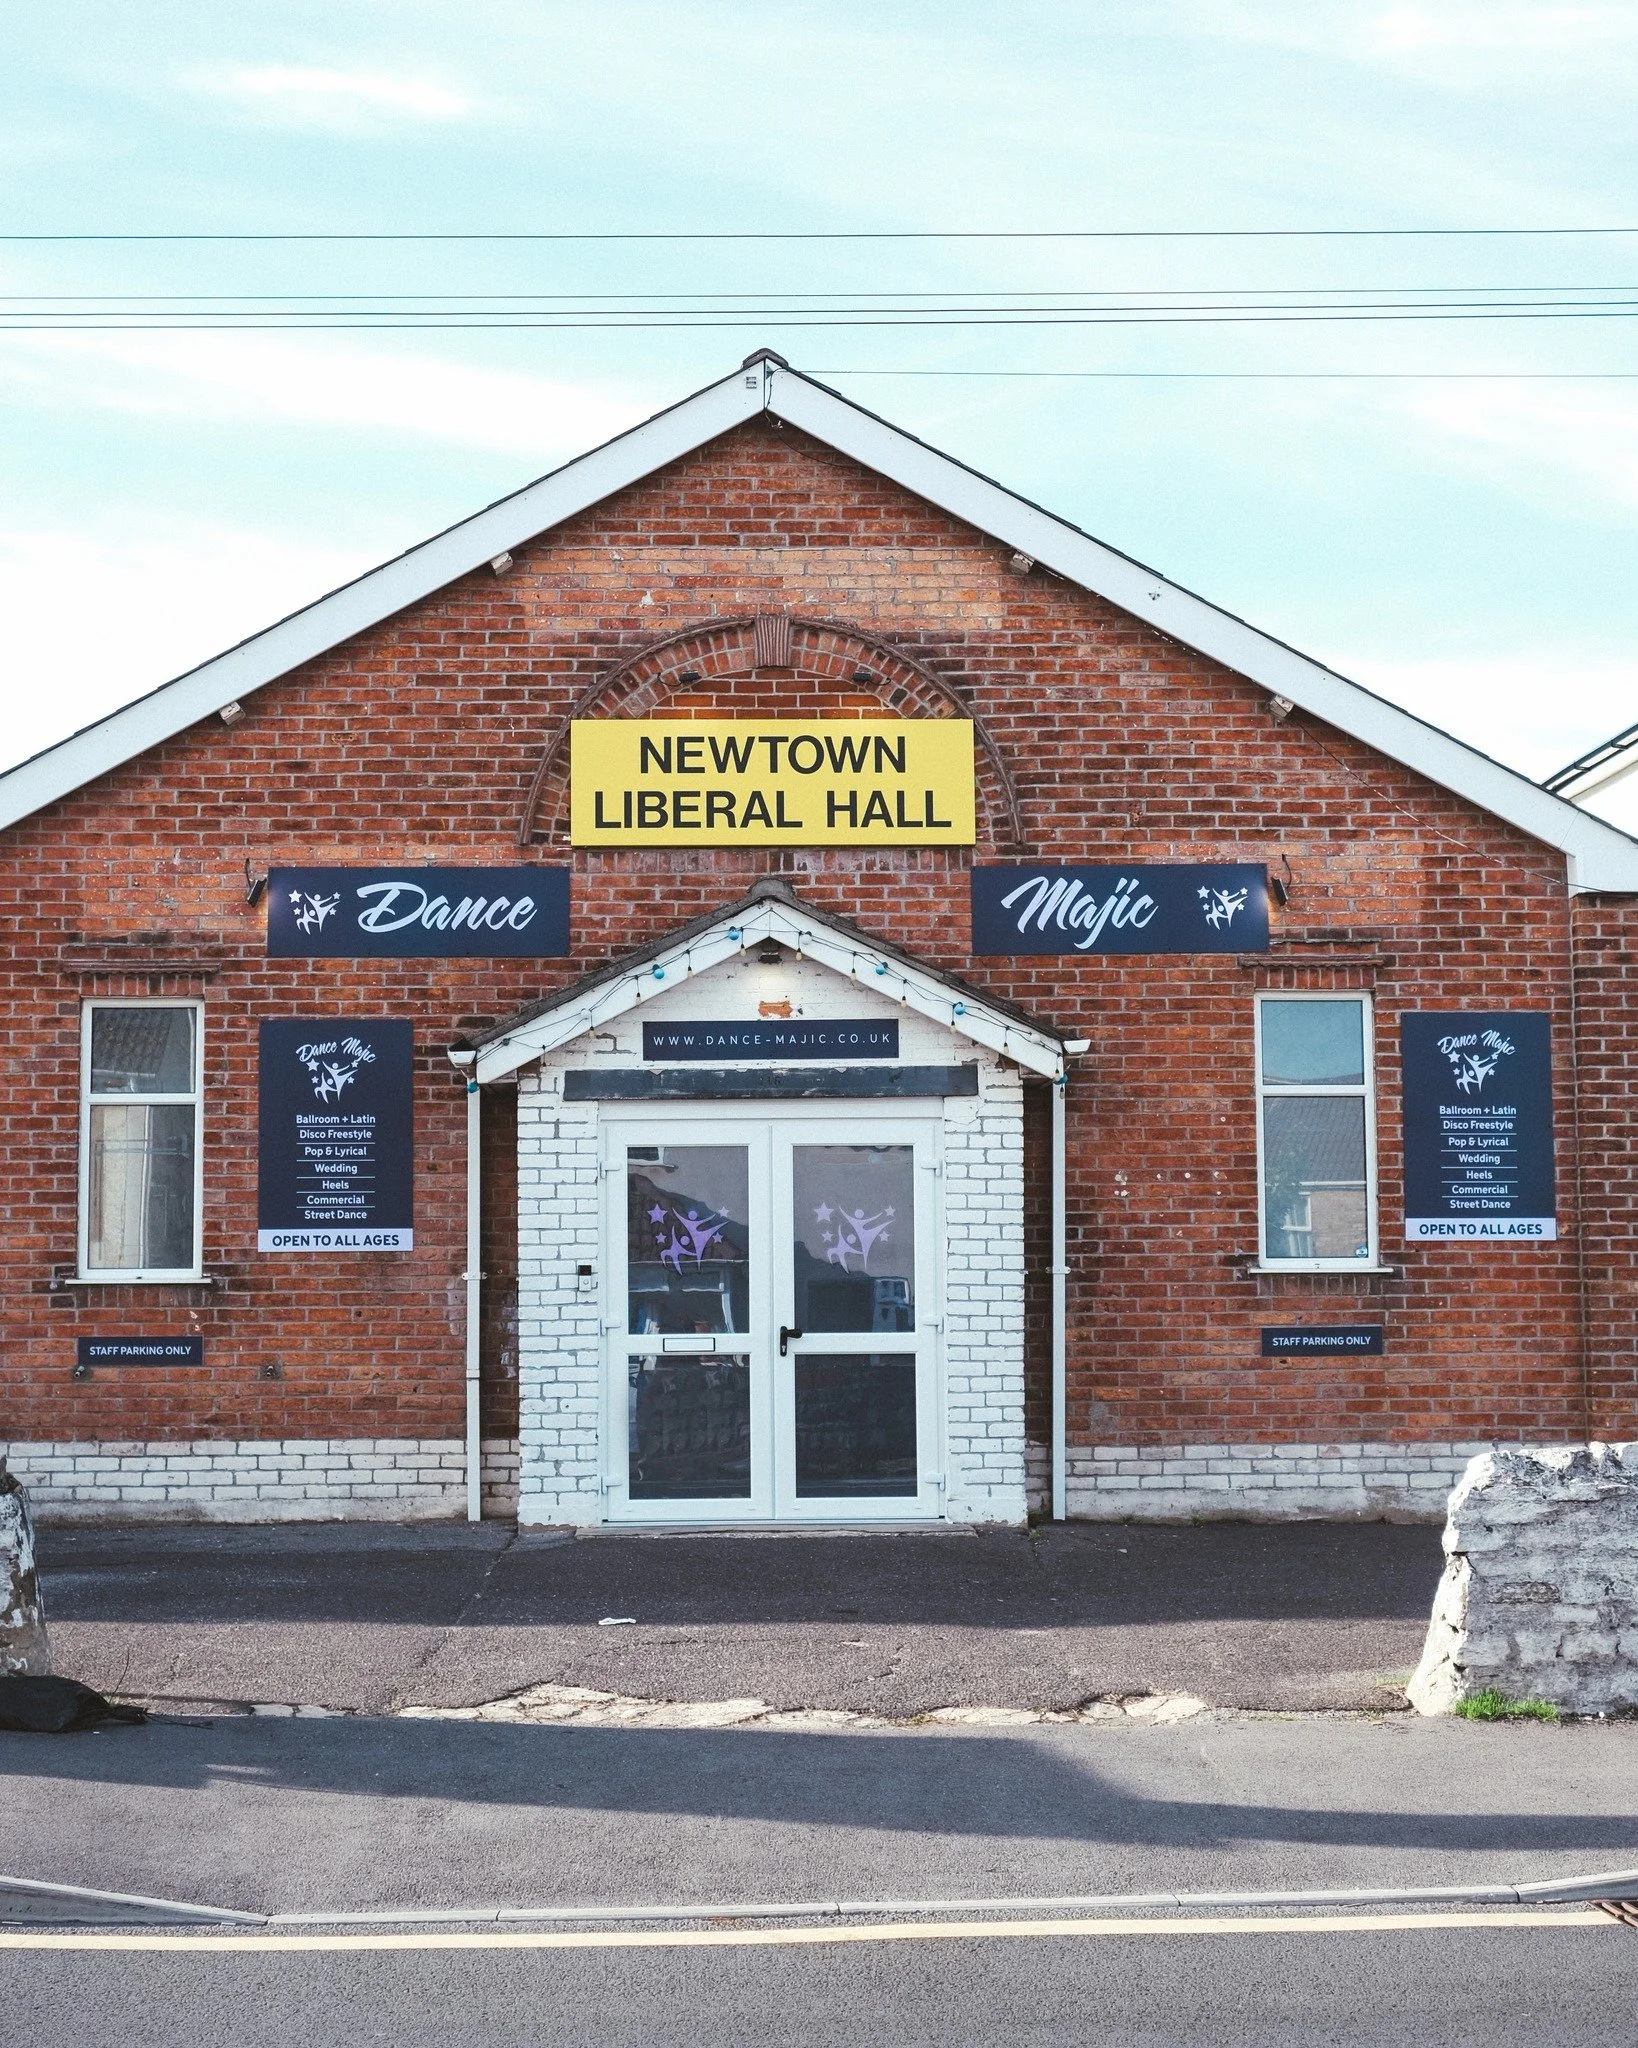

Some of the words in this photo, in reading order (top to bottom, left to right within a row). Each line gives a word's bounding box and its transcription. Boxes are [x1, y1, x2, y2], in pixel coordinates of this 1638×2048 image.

[640, 734, 906, 775] NEWTOWN
[594, 790, 803, 829] LIBERAL
[826, 790, 952, 828] HALL
[356, 881, 538, 933] Dance
[1000, 876, 1159, 949] Majic
[653, 1032, 890, 1046] WWW.DANCE-MAJIC.CO.UK
[1437, 1034, 1478, 1054] Dance
[1480, 1029, 1516, 1055] Majic
[295, 1042, 338, 1063] Dance
[340, 1037, 377, 1063] Majic
[1439, 1105, 1482, 1115] Ballroom
[1492, 1105, 1517, 1115] Latin
[296, 1114, 340, 1124] Ballroom
[350, 1114, 376, 1124] Latin
[1443, 1120, 1469, 1130] Disco
[1470, 1120, 1514, 1132] Freestyle
[300, 1129, 326, 1139] Disco
[327, 1129, 372, 1141] Freestyle
[1448, 1137, 1467, 1148] Pop
[1468, 1137, 1476, 1147] &
[1477, 1137, 1509, 1148] Lyrical
[304, 1146, 324, 1158] Pop
[325, 1146, 333, 1156] &
[334, 1146, 367, 1158] Lyrical
[1458, 1153, 1501, 1165] Wedding
[314, 1163, 358, 1175] Wedding
[1466, 1170, 1493, 1180] Heels
[322, 1180, 350, 1190] Heels
[1451, 1184, 1508, 1195] Commercial
[306, 1194, 365, 1205] Commercial
[1449, 1199, 1480, 1209] Street
[1481, 1199, 1511, 1209] Dance
[304, 1209, 335, 1220] Street
[337, 1209, 368, 1220] Dance
[1419, 1223, 1456, 1235] OPEN
[1458, 1223, 1477, 1235] TO
[1479, 1223, 1505, 1235] ALL
[1507, 1223, 1543, 1235] AGES
[272, 1234, 310, 1247] OPEN
[312, 1234, 331, 1247] TO
[334, 1234, 361, 1246] ALL
[363, 1234, 400, 1246] AGES
[1272, 1337, 1301, 1347] STAFF
[1302, 1337, 1344, 1346] PARKING
[1346, 1336, 1371, 1346] ONLY
[89, 1346, 119, 1356] STAFF
[120, 1346, 164, 1355] PARKING
[165, 1346, 192, 1355] ONLY
